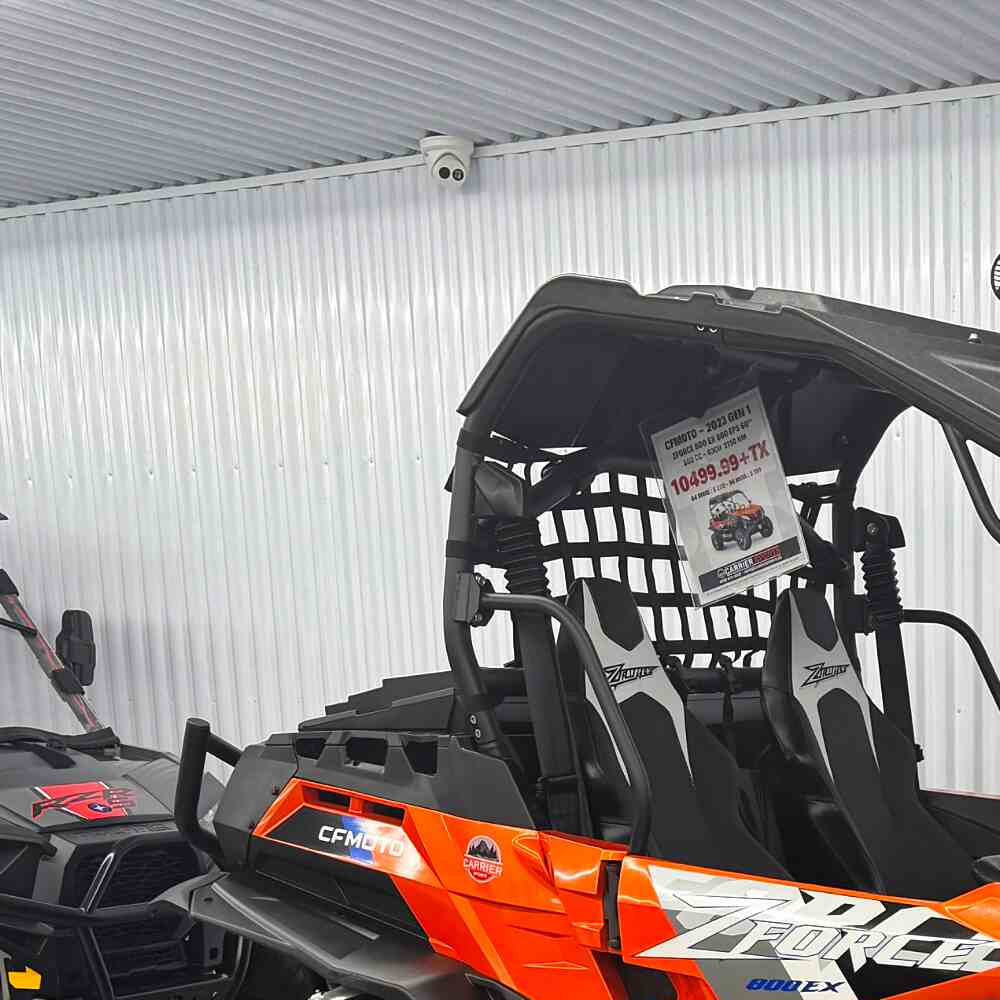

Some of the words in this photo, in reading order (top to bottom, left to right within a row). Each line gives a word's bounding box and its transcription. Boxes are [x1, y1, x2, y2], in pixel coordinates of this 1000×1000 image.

[664, 429, 698, 450] CFMOTO
[705, 415, 728, 433] 2023
[727, 406, 747, 423] GEN
[671, 440, 770, 495] 10499.99+TX
[318, 825, 405, 857] CFMOTO
[463, 857, 504, 878] CARRIER
[636, 894, 994, 974] ZFORCE
